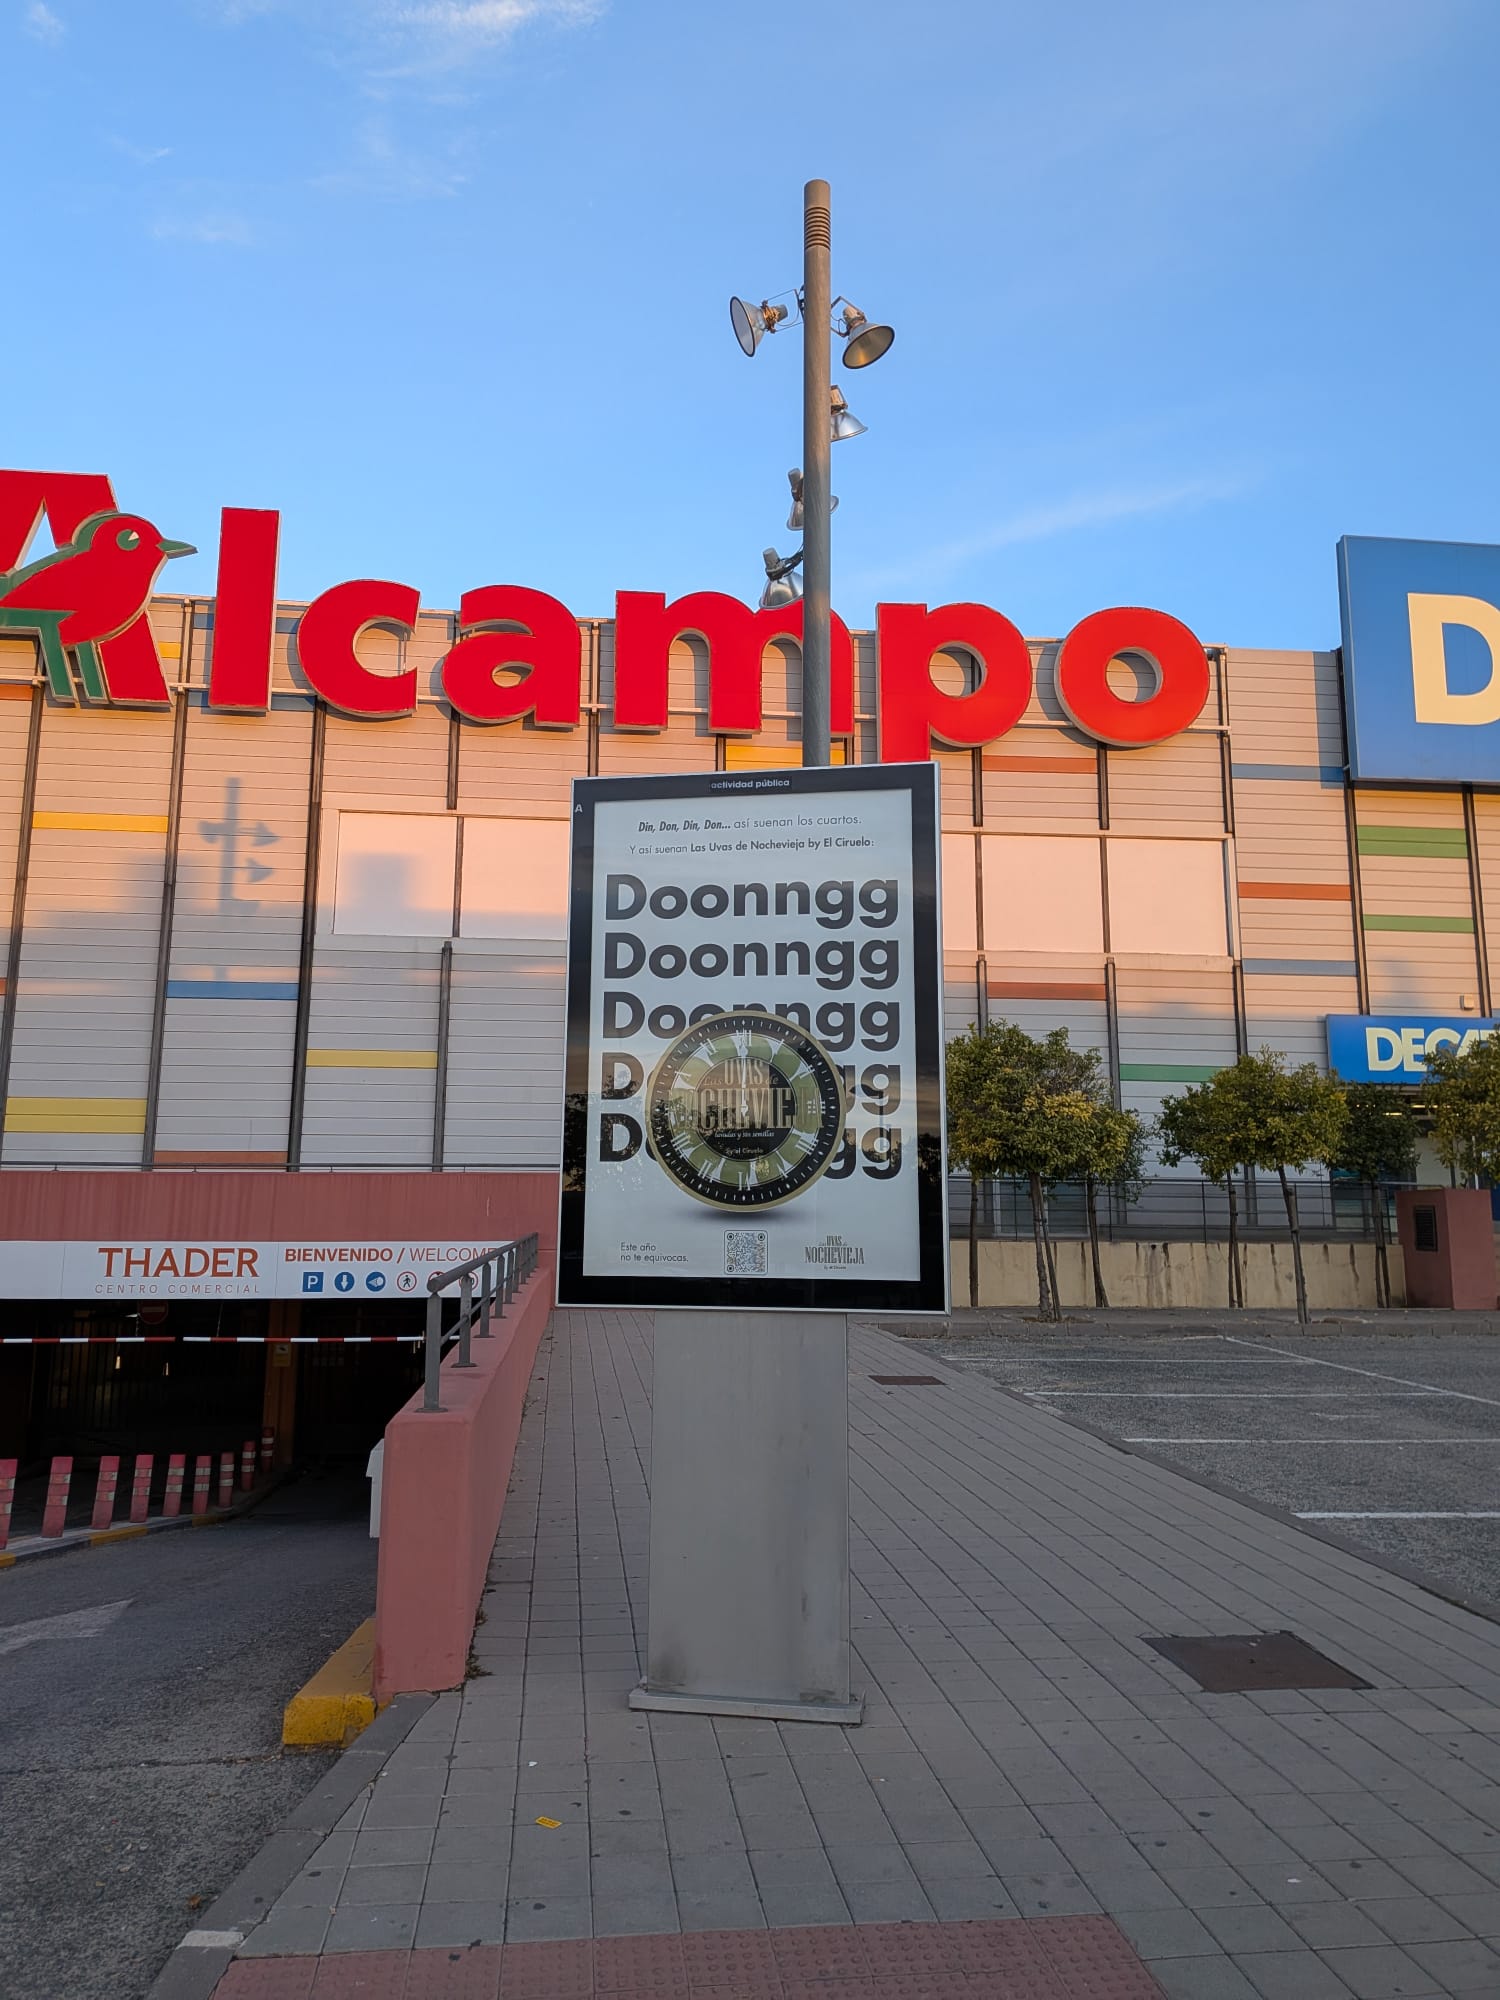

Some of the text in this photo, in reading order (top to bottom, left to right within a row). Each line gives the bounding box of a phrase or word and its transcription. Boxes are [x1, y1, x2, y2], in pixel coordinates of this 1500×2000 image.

[711, 779, 790, 789] actividad pública
[575, 804, 583, 813] A
[638, 815, 862, 833] Din, Don, Din, Don... así suenan los cuartos.
[630, 836, 874, 854] Y así suenan Las Uvas de Nochevieja by El Ciruelo:
[606, 873, 899, 929] Doonngg
[604, 931, 900, 991] Doonngg
[602, 991, 901, 1053] Dongg
[724, 1058, 764, 1086] UVAS
[285, 1248, 394, 1262] BIENVENIDO
[620, 1242, 656, 1252] Este año
[804, 1246, 865, 1264] NOCHEVIEJA
[98, 1248, 260, 1278] THADER
[620, 1253, 689, 1264] no te equivocas.
[94, 1284, 260, 1294] CENTRO COMERCIAL
